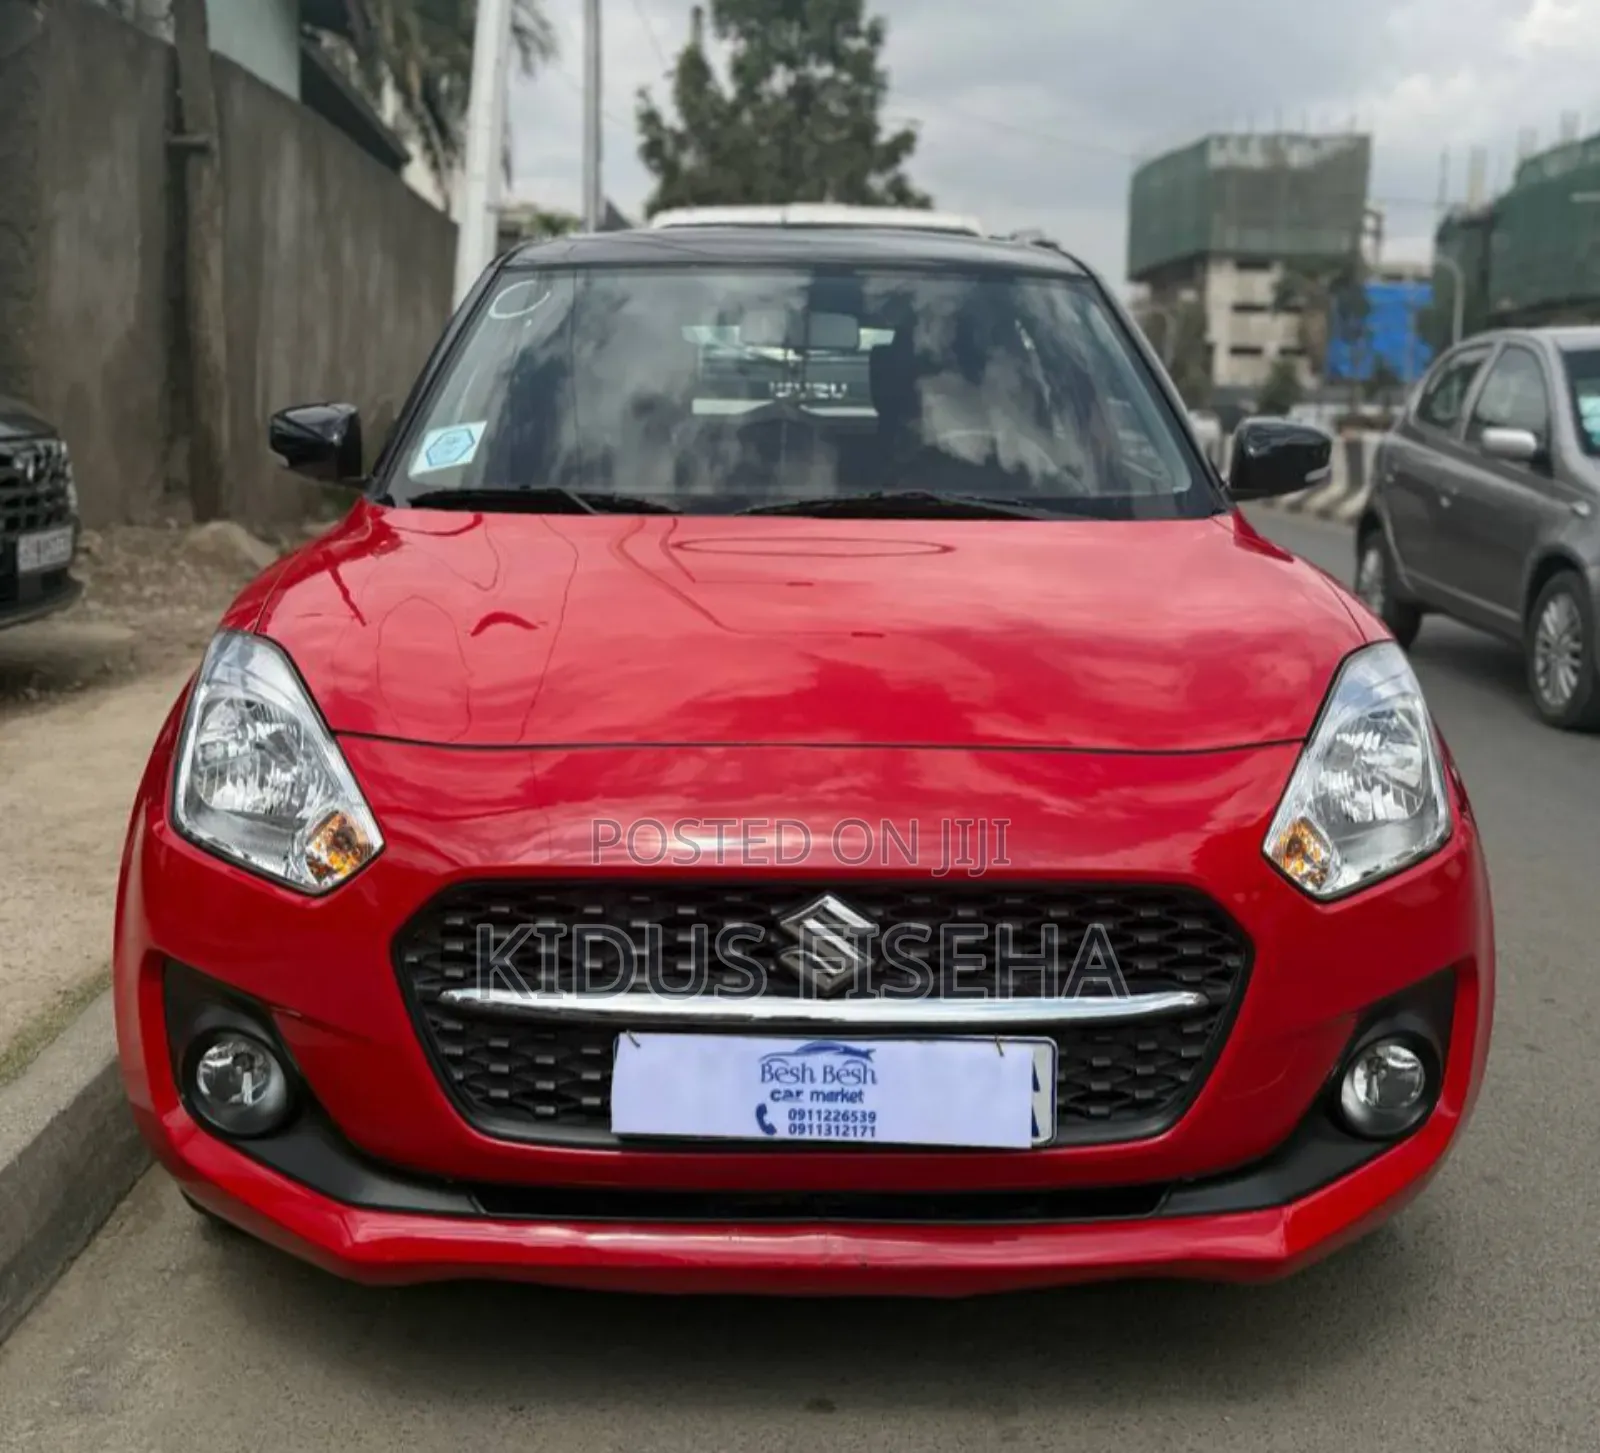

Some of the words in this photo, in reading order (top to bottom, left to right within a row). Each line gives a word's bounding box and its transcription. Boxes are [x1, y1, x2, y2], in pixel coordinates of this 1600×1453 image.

[761, 1060, 817, 1085] Besh
[822, 1061, 878, 1086] Besh
[770, 1089, 804, 1102] car
[810, 1087, 865, 1104] market
[787, 1108, 877, 1124] 0911226539
[787, 1122, 876, 1138] 0911312171
